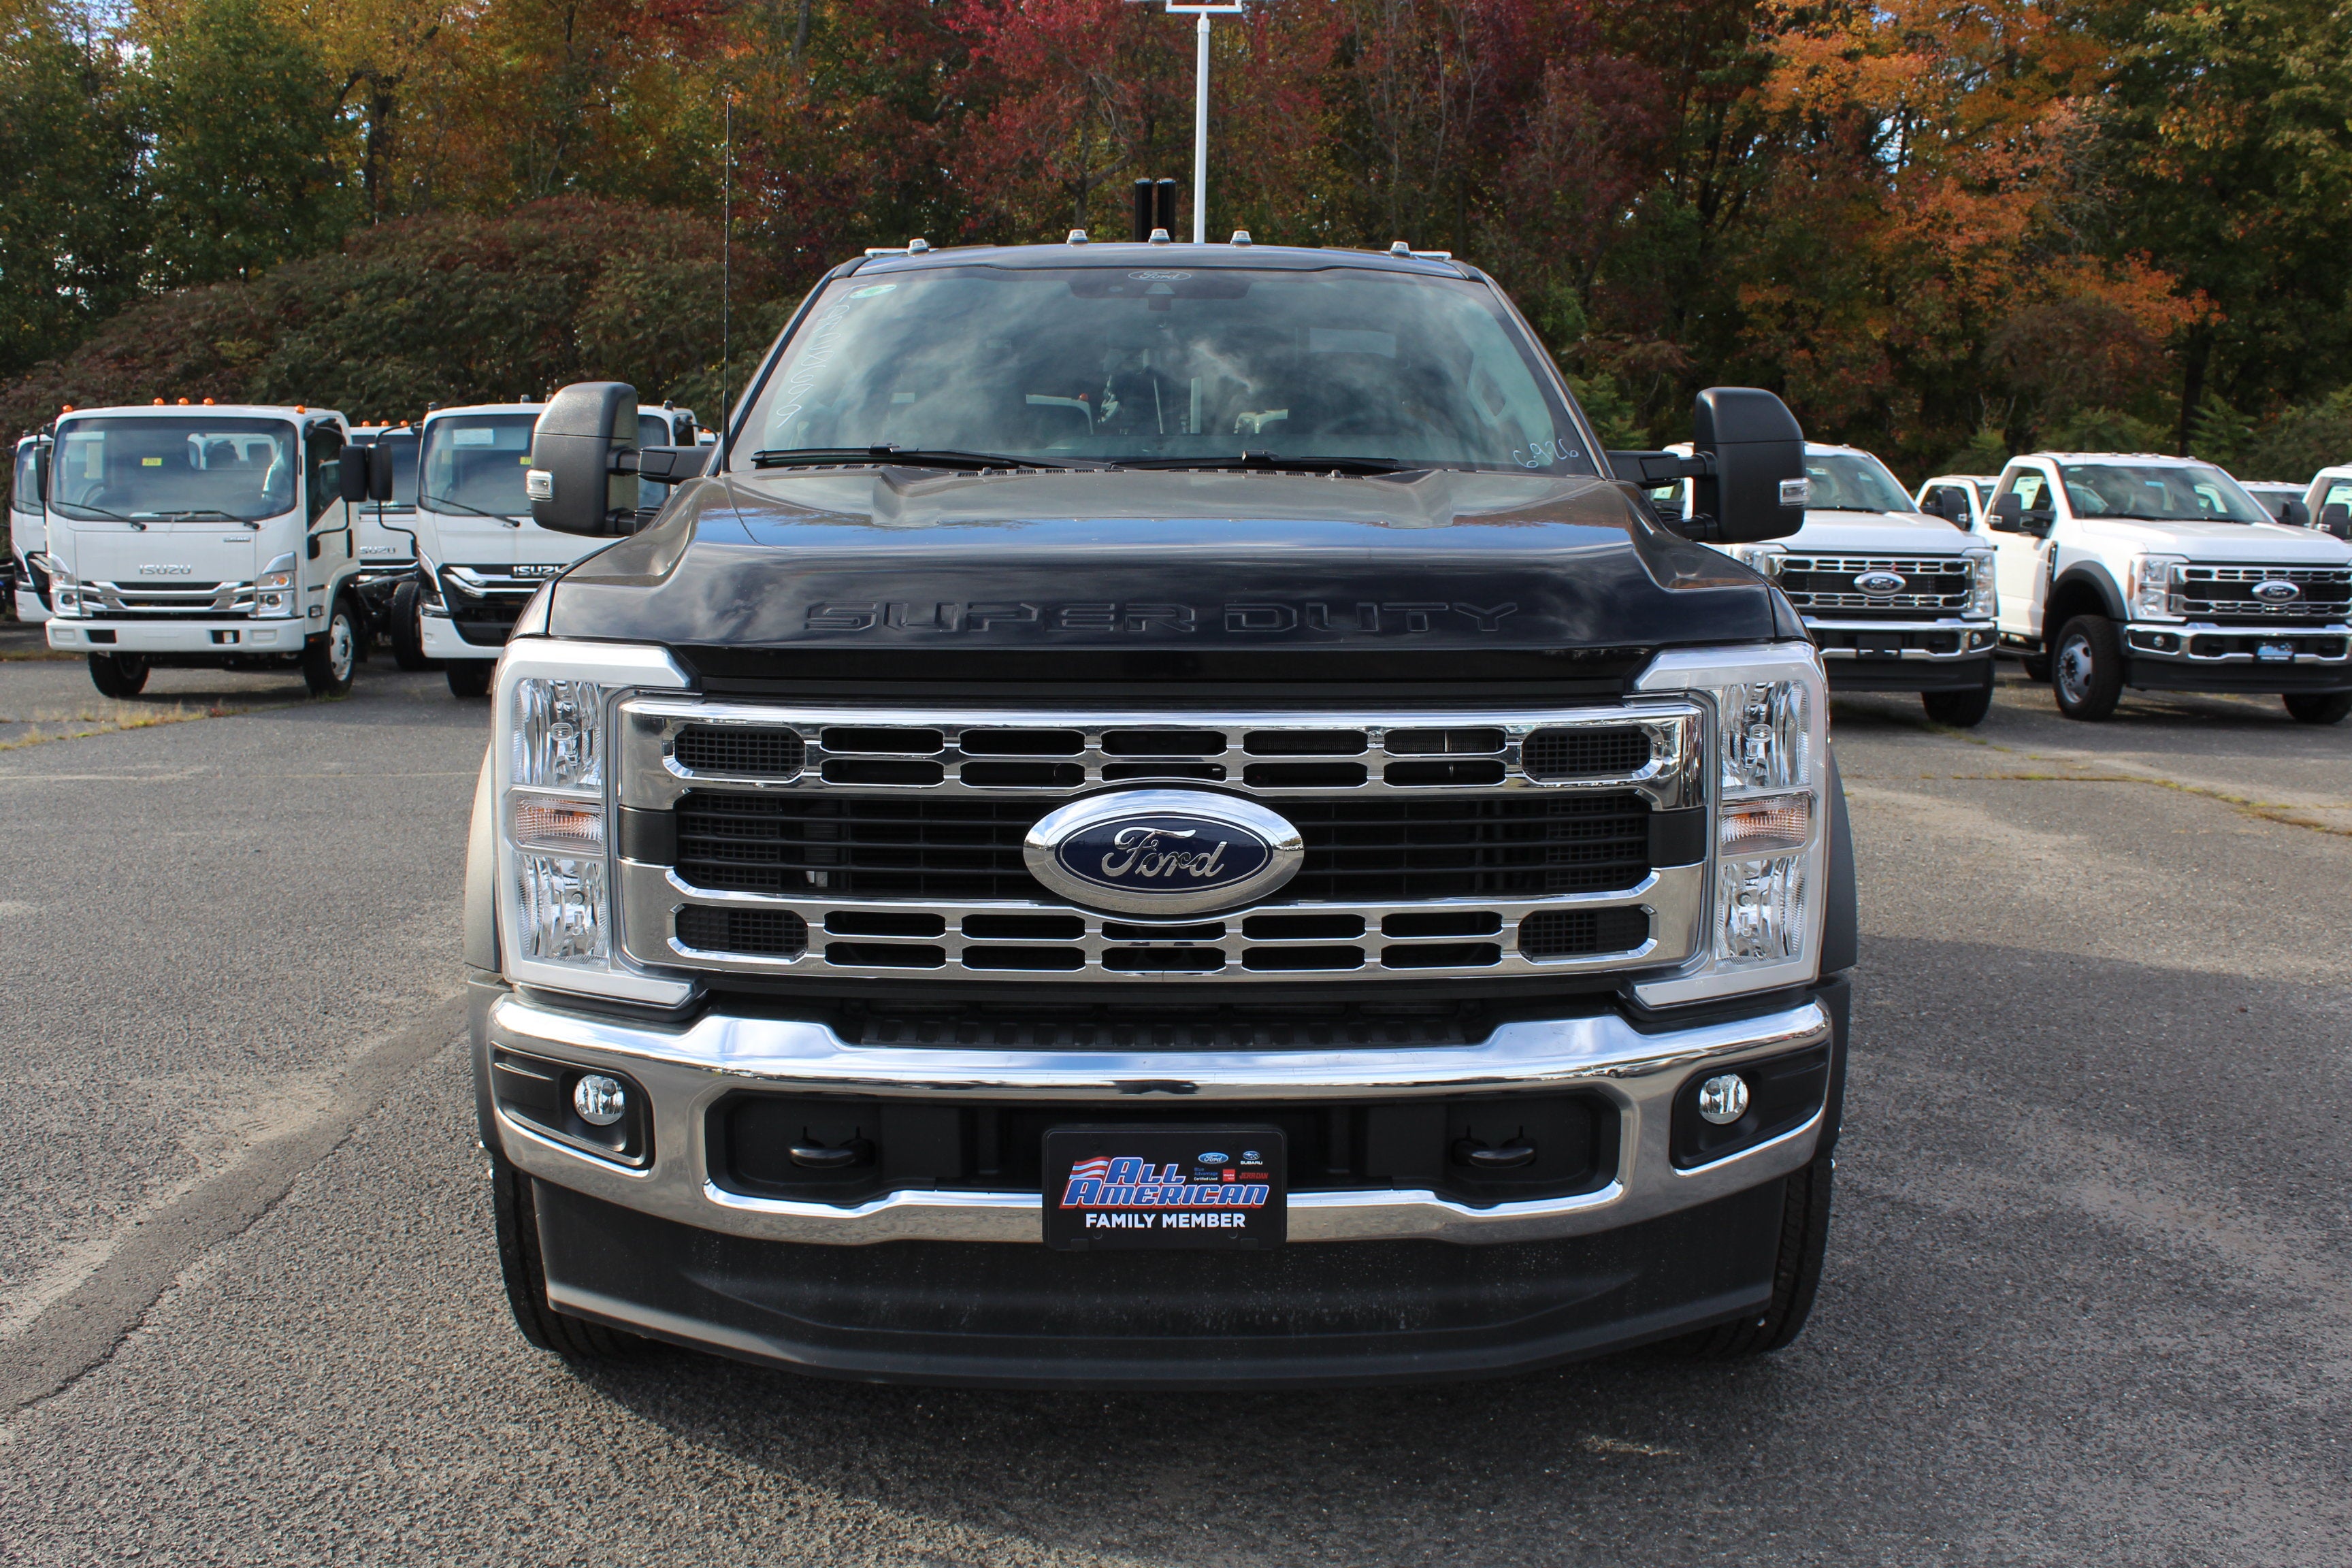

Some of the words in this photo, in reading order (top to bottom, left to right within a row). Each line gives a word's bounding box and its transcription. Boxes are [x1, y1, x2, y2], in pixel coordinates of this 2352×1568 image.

[1139, 272, 1180, 280] Ford
[359, 546, 396, 554] SUZU
[139, 564, 191, 575] ISUZU
[803, 600, 1196, 632] SUPER
[1224, 602, 1518, 632] DUTY
[1100, 826, 1228, 877] Ford
[1085, 1213, 1156, 1228] FAMILY
[1162, 1213, 1245, 1228] MEMBER
